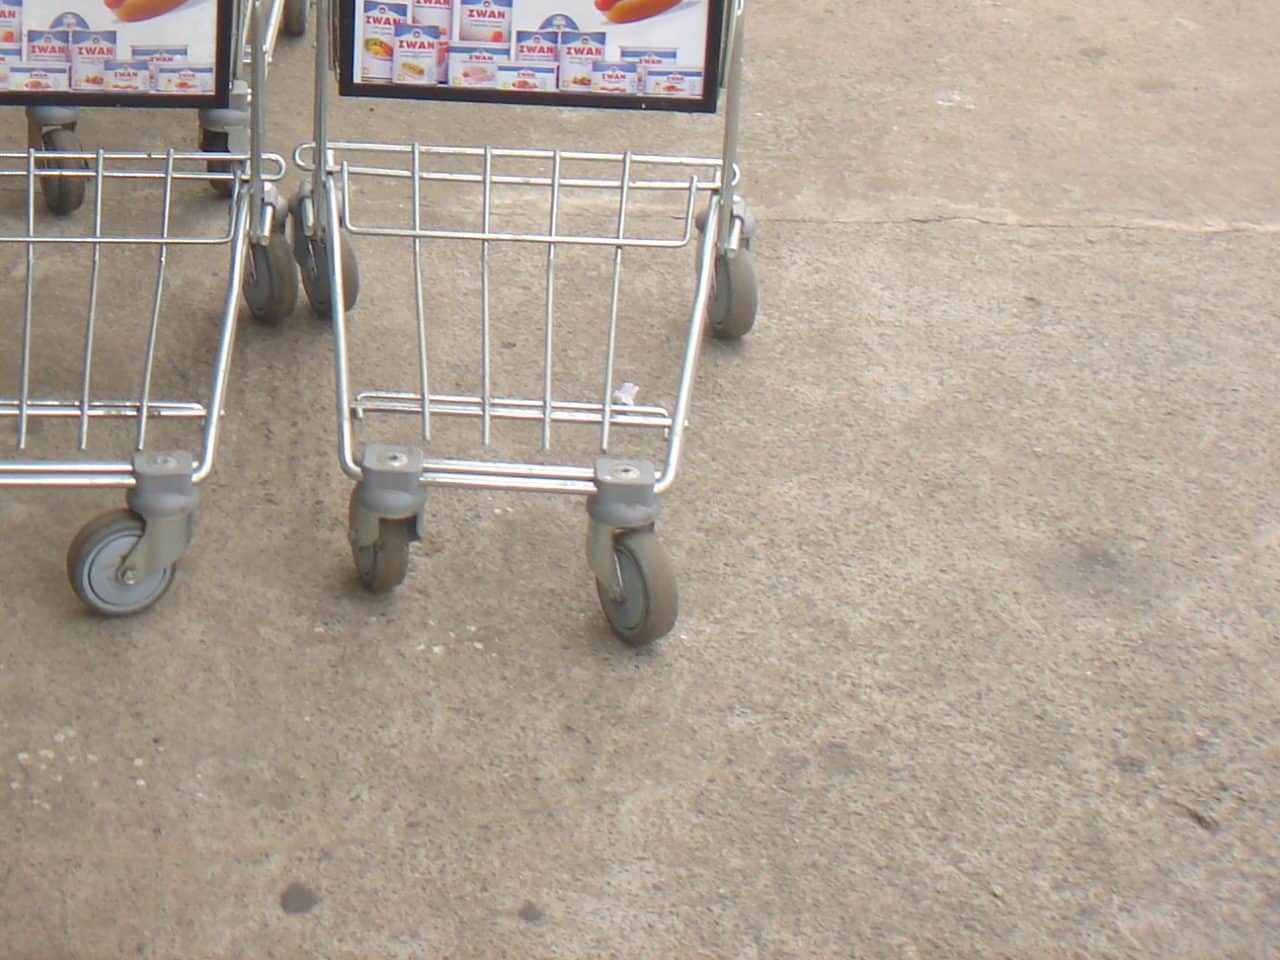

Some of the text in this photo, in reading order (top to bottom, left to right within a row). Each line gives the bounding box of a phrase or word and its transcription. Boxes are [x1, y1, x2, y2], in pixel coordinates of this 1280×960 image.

[467, 9, 505, 19] ZWAN
[398, 40, 435, 49] ZWAN
[31, 45, 66, 54] ZWAN
[77, 46, 114, 56] ZWAN
[519, 45, 554, 54] ZWAN
[565, 46, 602, 56] ZWAN
